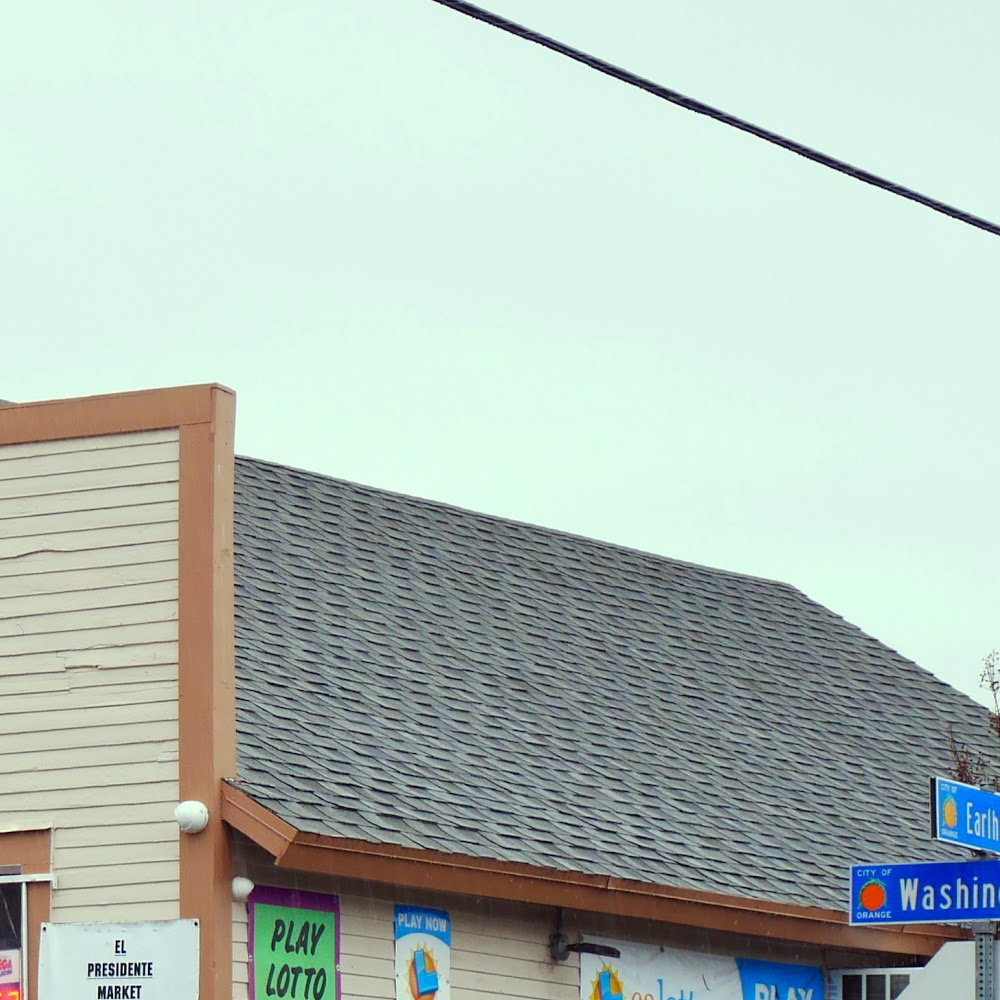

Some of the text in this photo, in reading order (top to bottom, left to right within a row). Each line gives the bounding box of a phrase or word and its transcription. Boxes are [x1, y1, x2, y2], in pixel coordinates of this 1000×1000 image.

[941, 782, 958, 794] CITY OF
[941, 828, 959, 839] ORANGE
[857, 868, 893, 877] CITY OF
[900, 876, 1000, 911] Washin
[856, 910, 892, 919] ORANGE
[397, 913, 447, 933] PLAY NOW
[271, 918, 326, 957] PLAY
[114, 939, 127, 954] EL
[87, 961, 153, 978] PRESIDENTE
[97, 985, 142, 1000] MARKET
